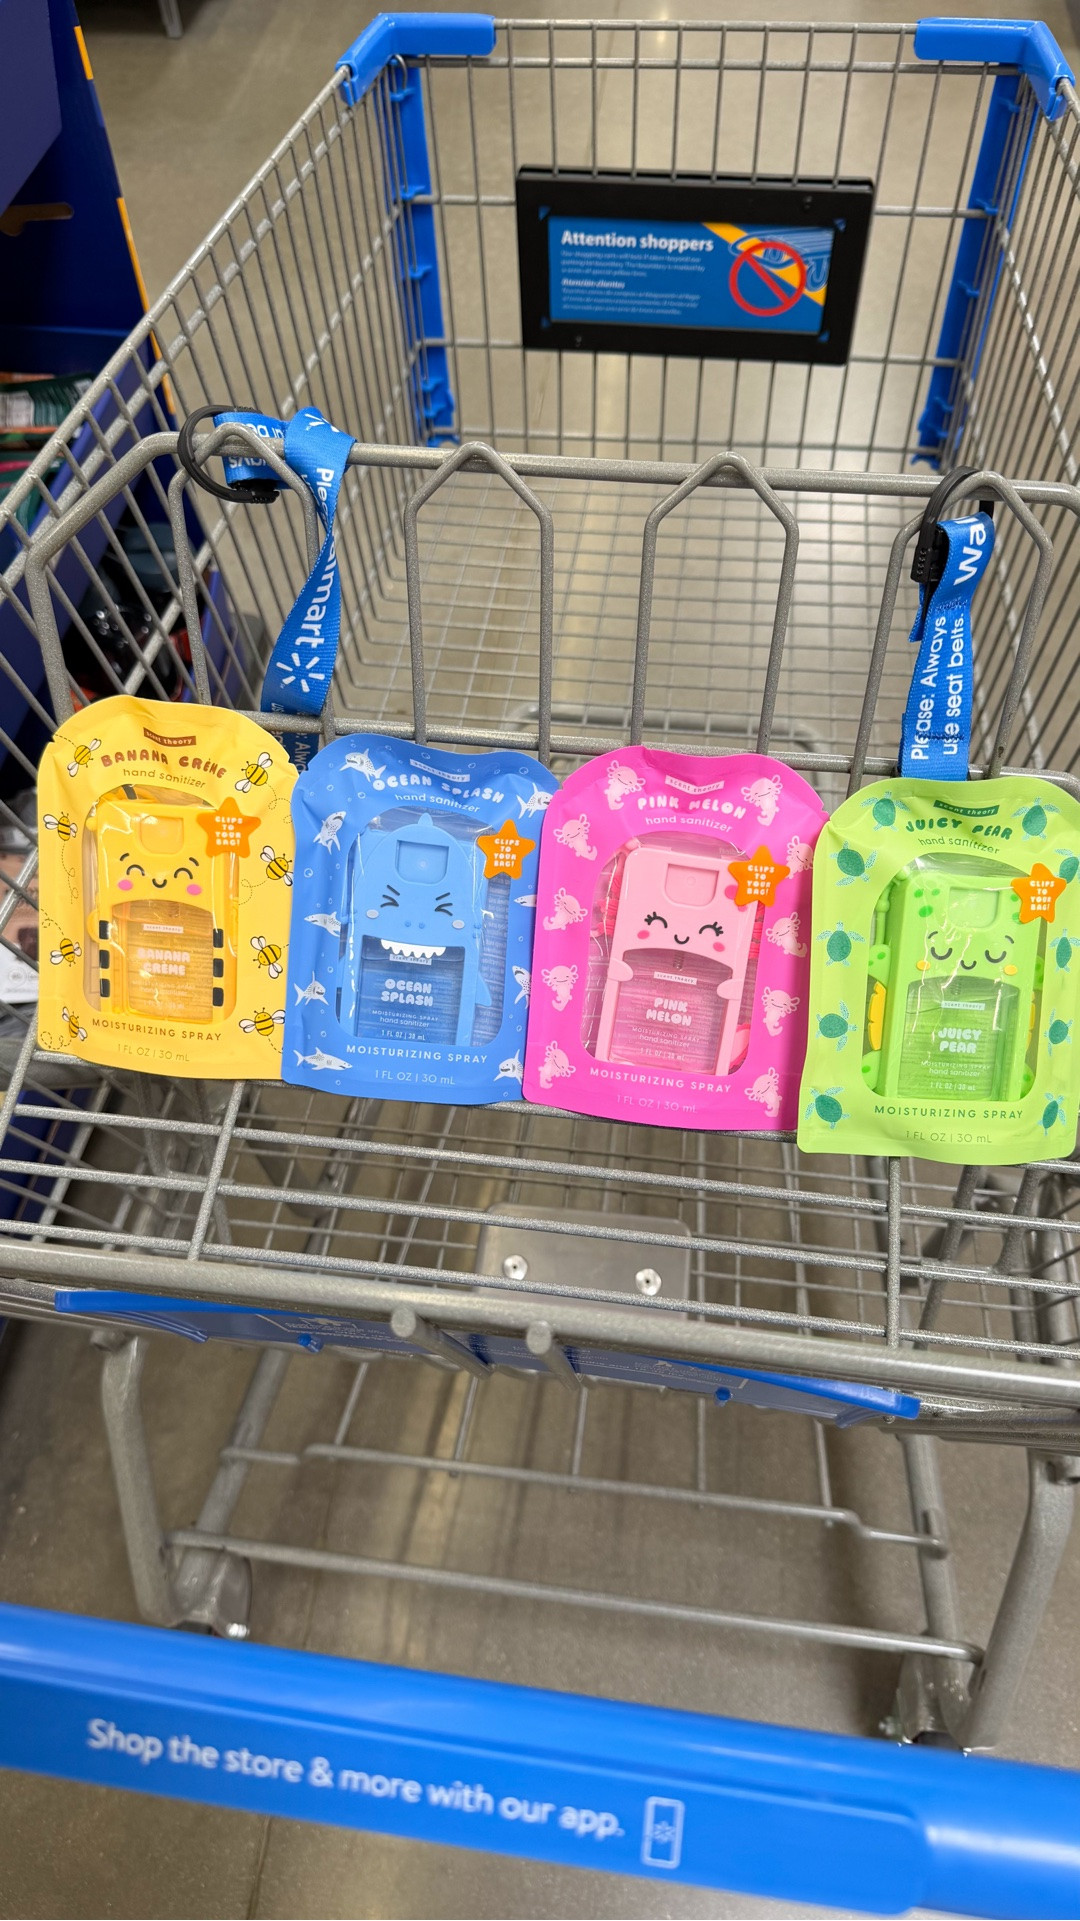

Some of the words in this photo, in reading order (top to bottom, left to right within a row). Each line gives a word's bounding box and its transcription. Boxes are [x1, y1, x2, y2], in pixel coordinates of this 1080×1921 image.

[561, 230, 637, 248] Attention
[640, 233, 715, 253] shoppers
[295, 540, 337, 649] almart
[949, 613, 964, 667] belts.
[911, 693, 935, 760] Please:
[923, 616, 946, 687] Always
[945, 673, 964, 717] seat
[943, 719, 960, 755] use
[100, 749, 169, 767] BANANA
[178, 757, 228, 779] CRÈME
[123, 768, 156, 777] hand
[159, 772, 207, 788] sanitizer
[670, 779, 691, 791] scent
[693, 783, 720, 793] theory
[372, 774, 432, 791] OCEAN
[441, 782, 505, 803] SPLASH
[394, 793, 426, 802] hand
[429, 795, 481, 813] sanitizer
[637, 795, 679, 810] PINK
[688, 798, 747, 819] MELON
[939, 803, 963, 813] scent
[215, 816, 243, 824] CLIPS
[645, 815, 677, 825] hand
[680, 817, 733, 833] sanitizer
[215, 831, 241, 839] YOUR
[905, 817, 963, 832] JUICY
[971, 824, 1013, 840] PEAR
[215, 838, 240, 846] BAG!
[494, 838, 520, 846] CLIPS
[918, 836, 945, 846] hand
[948, 837, 1000, 855] sanitizer
[493, 860, 515, 868] BAG!
[494, 853, 517, 861] YOUR
[747, 865, 775, 873] CLIPS
[746, 880, 772, 888] YOUR
[746, 887, 769, 896] BAG!
[1029, 880, 1055, 888] CLIPS
[1037, 888, 1048, 896] TO
[137, 947, 191, 963] BANANA
[384, 978, 432, 994] OCEAN
[381, 990, 434, 1007] SPLASH
[653, 997, 688, 1013] PINK
[372, 1010, 417, 1019] MOISTURIZING
[380, 1016, 399, 1024] hand
[400, 1019, 430, 1028] sanitizer
[645, 1009, 692, 1026] MELON
[92, 1018, 176, 1037] MOISTURIZING
[181, 1031, 222, 1041] SPRAY
[937, 1028, 983, 1041] JUICY
[123, 1045, 133, 1055] FL
[136, 1047, 150, 1057] OZ
[158, 1050, 173, 1059] 30
[176, 1052, 190, 1062] mL
[346, 1045, 442, 1061] MOISTURIZING
[447, 1053, 488, 1063] SPRAY
[939, 1041, 977, 1054] PEAR
[382, 1071, 394, 1080] FL
[397, 1072, 412, 1081] OZ
[421, 1074, 437, 1083] 30
[440, 1075, 456, 1085] mL
[590, 1067, 685, 1088] MOISTURIZING
[690, 1081, 732, 1093] SPRAY
[929, 1067, 949, 1075] hand
[950, 1069, 980, 1077] sanitizer
[623, 1095, 635, 1105] FL
[638, 1097, 653, 1108] OZ
[664, 1101, 679, 1111] 30
[874, 1105, 977, 1118] MOISTURIZING
[983, 1110, 1023, 1119] SPRAY
[913, 1131, 925, 1141] FL
[930, 1132, 946, 1142] OZ
[957, 1133, 973, 1143] 30
[976, 1134, 992, 1144] mL
[86, 1717, 163, 1765] Shop
[168, 1734, 220, 1769] the
[223, 1747, 304, 1783] store
[307, 1756, 334, 1788] &
[338, 1768, 423, 1805] more
[426, 1780, 494, 1815] with
[498, 1796, 556, 1825] our
[558, 1805, 626, 1841] app.
